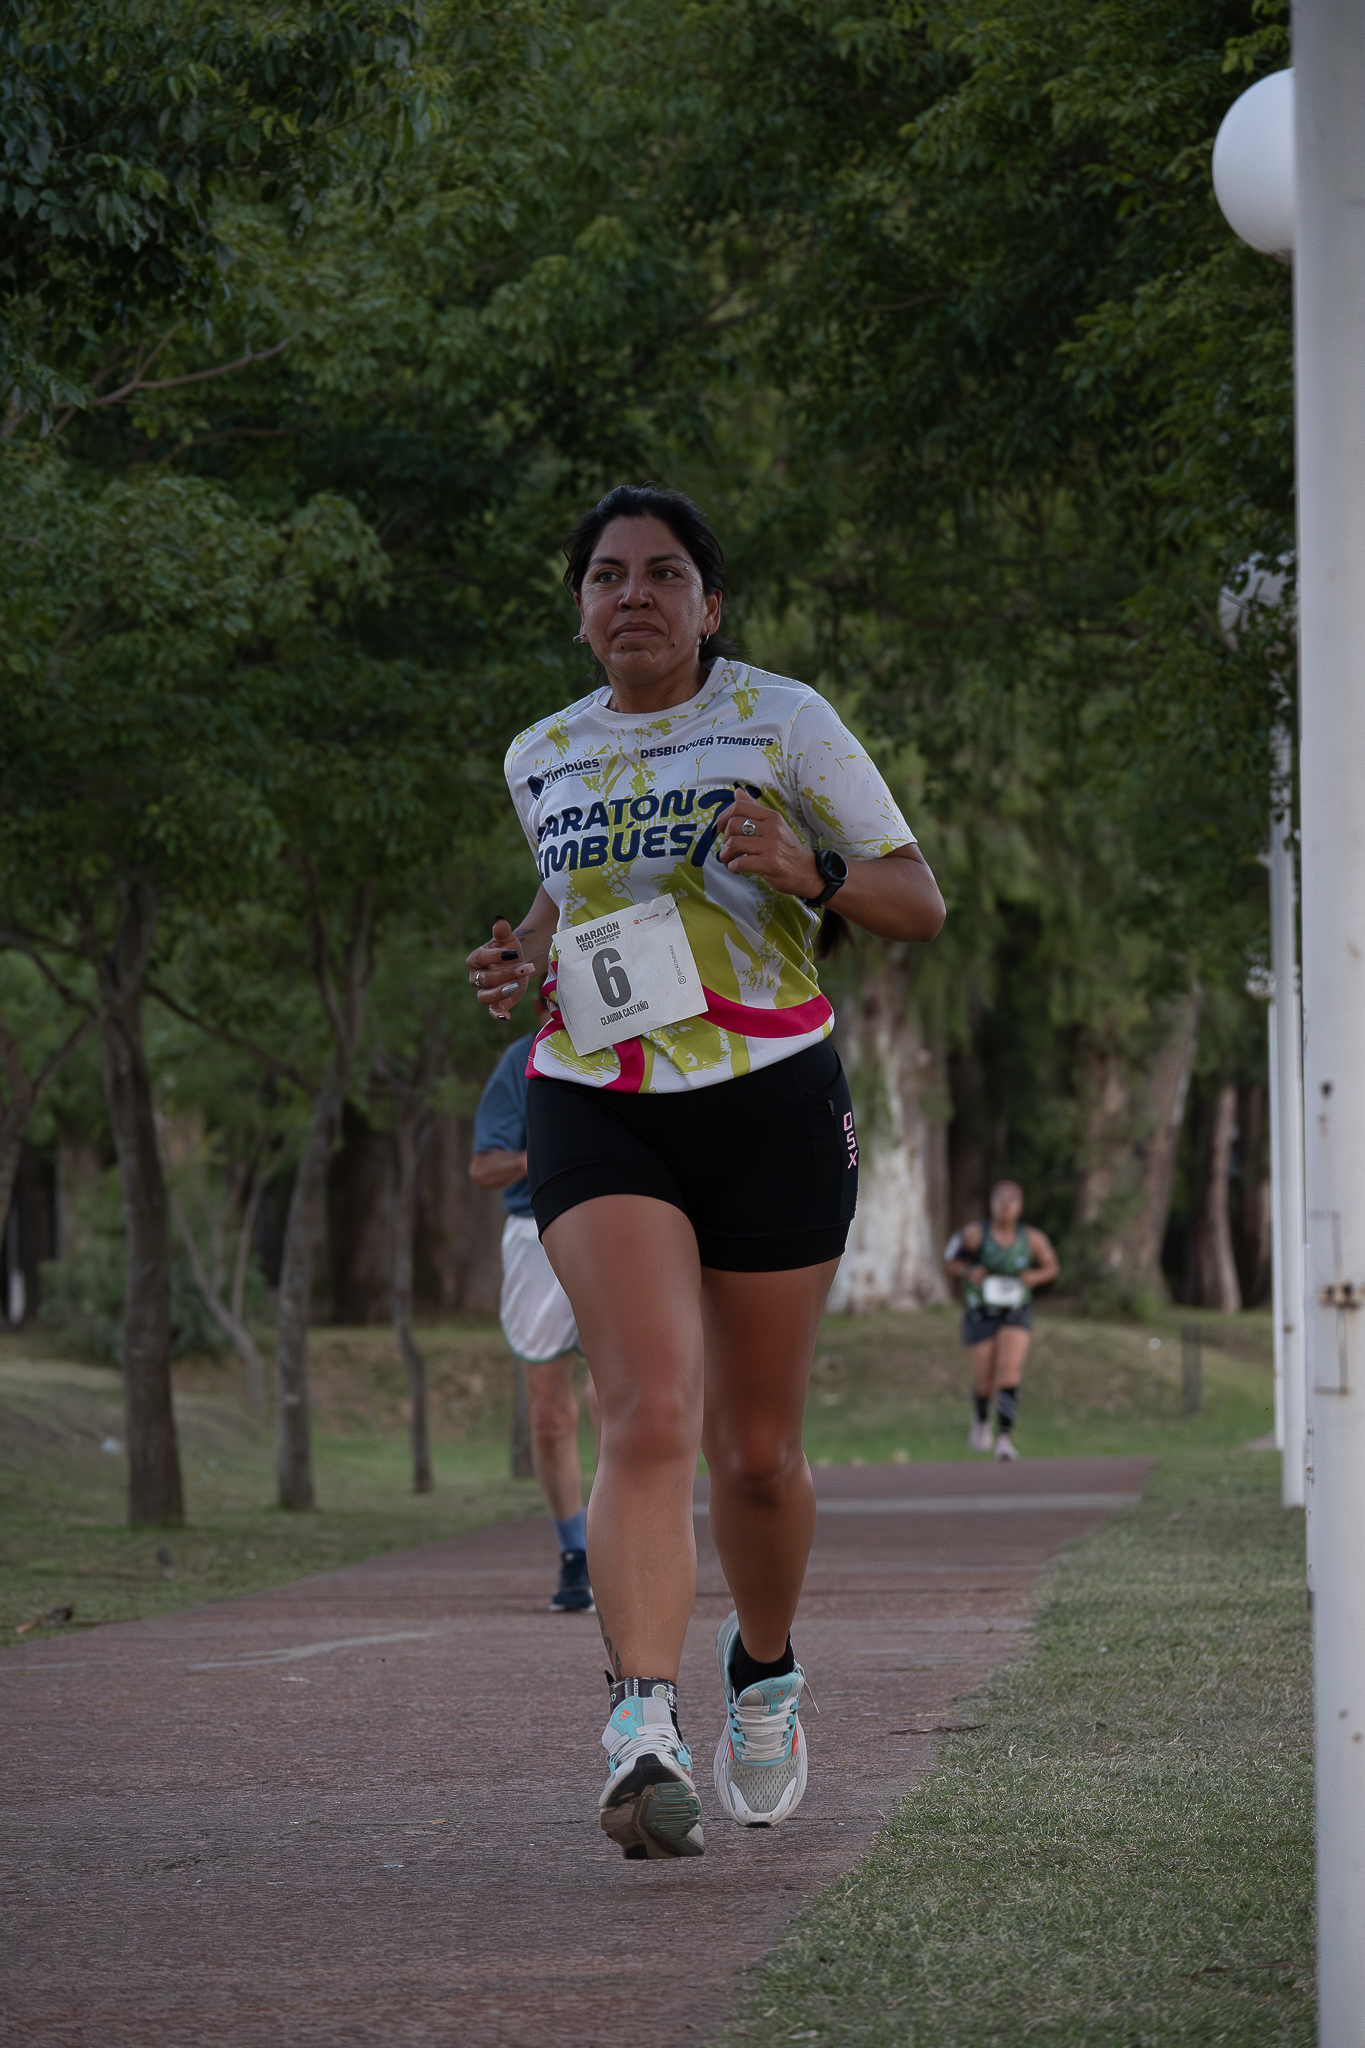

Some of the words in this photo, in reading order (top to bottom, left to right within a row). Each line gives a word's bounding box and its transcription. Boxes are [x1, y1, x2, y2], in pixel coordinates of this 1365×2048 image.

[716, 735, 774, 747] TIMBÚES
[544, 758, 600, 784] Timbúes
[538, 821, 698, 881] IMBÚES
[575, 921, 620, 945] MARATÓN
[578, 940, 594, 952] 150
[592, 947, 632, 1008] 6
[600, 1010, 624, 1026] CLAUDIA
[622, 1000, 650, 1018] CASTAÑO
